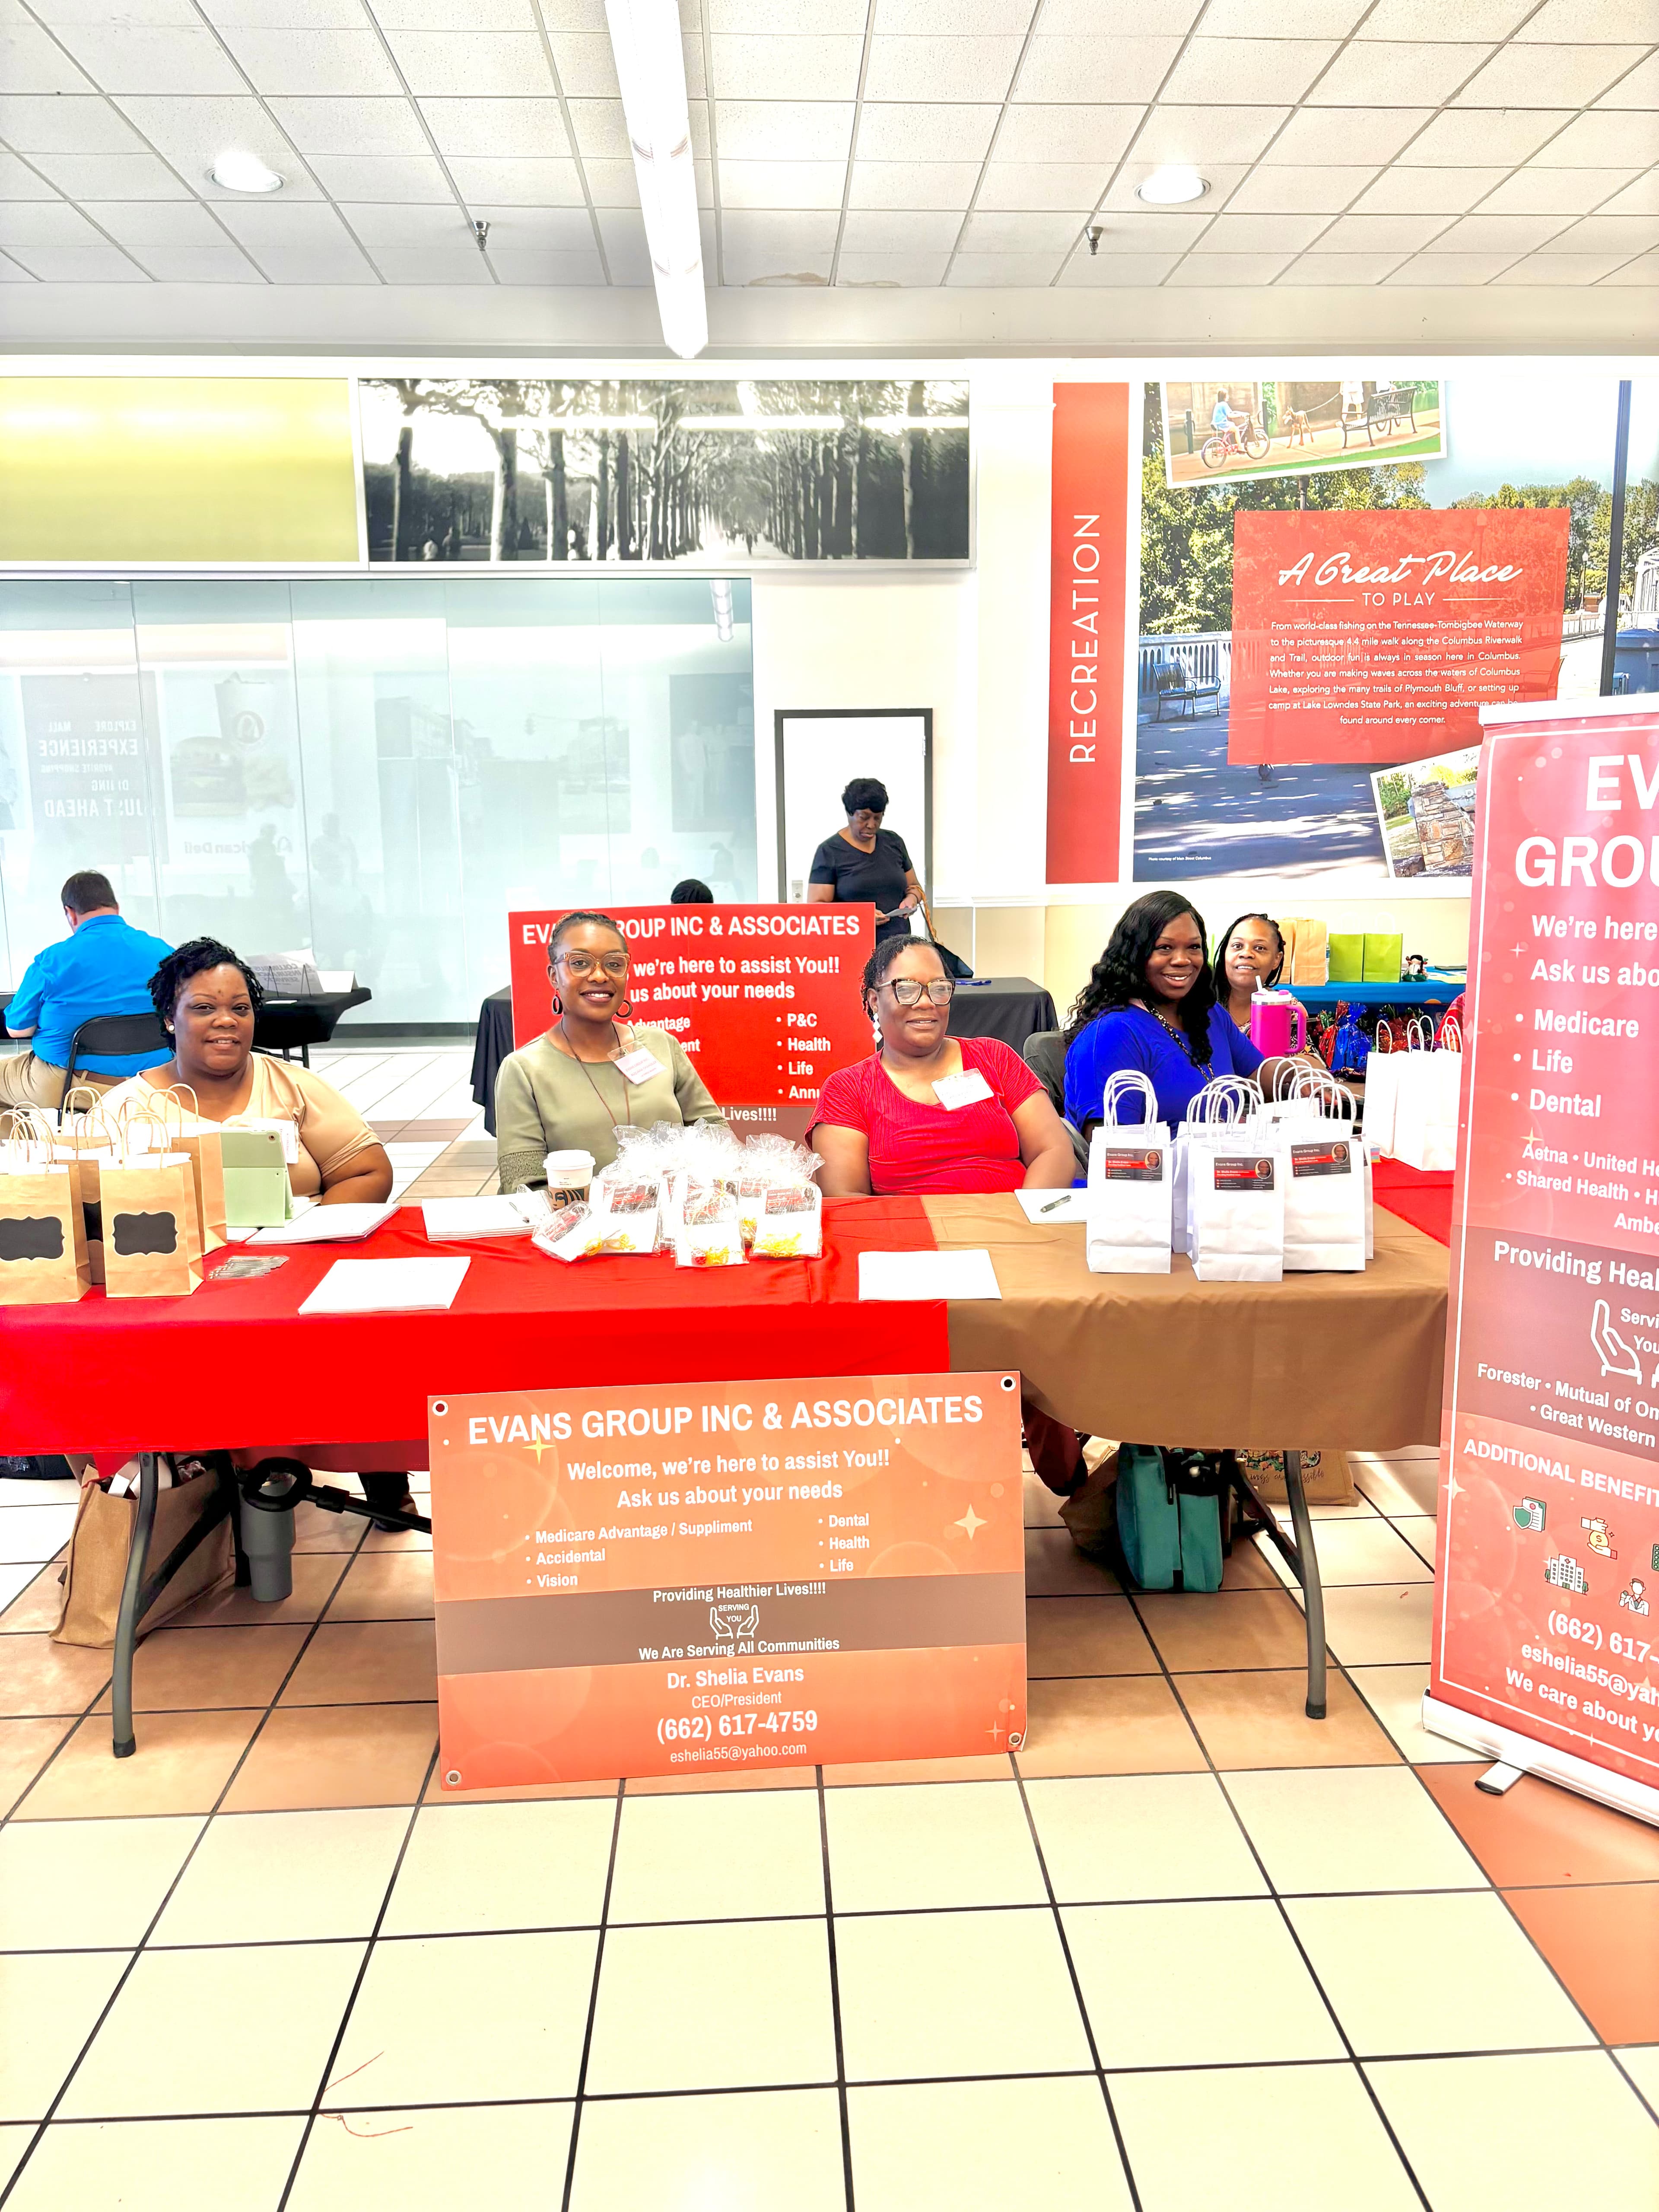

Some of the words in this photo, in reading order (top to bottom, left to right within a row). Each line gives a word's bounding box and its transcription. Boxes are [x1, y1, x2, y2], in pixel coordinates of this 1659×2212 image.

[1278, 552, 1314, 585] A
[1314, 553, 1425, 585] Great
[1422, 550, 1523, 585] Place
[1362, 593, 1385, 606] TO
[1393, 592, 1435, 606] PLAY
[1294, 621, 1337, 629] world-class
[1339, 621, 1365, 631] fishing
[1393, 620, 1482, 630] Tennessee-Tombigbee
[1484, 620, 1523, 629] Waterway
[1069, 515, 1100, 762] RECREATION
[1297, 638, 1344, 648] picturesque
[1402, 637, 1423, 647] along
[1442, 636, 1482, 644] Columbus
[1270, 653, 1285, 662] and
[1289, 653, 1307, 662] Trail,
[1312, 653, 1344, 661] outdoor
[1348, 653, 1360, 661] fun
[1374, 653, 1399, 662] always
[1478, 652, 1520, 660] Columbus.
[1270, 669, 1304, 677] Whether
[1340, 669, 1368, 679] making
[1269, 685, 1289, 694] Lake,
[1293, 685, 1330, 696] exploring
[1405, 684, 1441, 694] Plymouth
[1445, 683, 1464, 692] Bluff,
[1479, 684, 1505, 693] setting
[1324, 700, 1358, 709] Lowndes
[1384, 700, 1402, 709] Park,
[1417, 700, 1447, 709] exciting
[671, 917, 702, 935] INC
[710, 916, 723, 935] &
[728, 916, 859, 935] ASSOCIATES
[1532, 915, 1597, 938] We’re
[1604, 916, 1658, 941] here
[633, 959, 674, 976] we’re
[679, 957, 714, 973] here
[719, 957, 735, 973] to
[741, 956, 791, 973] assist
[795, 957, 839, 973] You!!
[1531, 959, 1576, 982] Ask
[1583, 966, 1610, 984] us
[630, 988, 649, 1002] us
[653, 983, 697, 1001] about
[702, 985, 739, 1001] your
[745, 981, 795, 998] needs
[788, 1014, 817, 1027] P&C
[1535, 1009, 1639, 1038] Medicare
[788, 1037, 831, 1052] Health
[788, 1061, 814, 1075] Life
[1532, 1049, 1573, 1074] Life
[1530, 1089, 1601, 1117] Dental
[721, 1107, 777, 1121] Lives!!!!
[1522, 1144, 1568, 1164] Aetna
[1583, 1151, 1637, 1174] United
[1516, 1170, 1571, 1192] Shared
[1576, 1179, 1629, 1201] Health
[1614, 1213, 1659, 1235] Ambe
[1494, 1240, 1602, 1285] Providing
[1609, 1261, 1659, 1292] Heal
[1621, 1308, 1659, 1329] Servi
[1634, 1335, 1659, 1355] You
[1478, 1363, 1541, 1390] Forester
[1555, 1381, 1609, 1408] Mutual
[1615, 1397, 1632, 1414] of
[469, 1413, 572, 1444] EVANS
[582, 1407, 692, 1437] GROUP
[702, 1404, 752, 1432] INC
[763, 1403, 783, 1430] &
[791, 1395, 982, 1428] ASSOCIATES
[1540, 1404, 1583, 1429] Great
[1587, 1416, 1656, 1448] Western
[567, 1461, 656, 1480] Welcome,
[662, 1457, 711, 1475] we’re
[717, 1455, 756, 1472] here
[761, 1454, 779, 1471] to
[785, 1451, 838, 1469] assist
[843, 1449, 889, 1467] You!!
[1463, 1438, 1576, 1483] ADDITIONAL
[617, 1489, 652, 1507] Ask
[658, 1492, 679, 1506] us
[685, 1486, 737, 1504] about
[742, 1487, 783, 1505] your
[789, 1481, 842, 1499] needs
[829, 1513, 869, 1527] Dental
[536, 1529, 595, 1543] Medicare
[598, 1525, 667, 1539] Advantage
[679, 1519, 752, 1536] Suppliment
[830, 1535, 870, 1550] Health
[536, 1548, 605, 1564] Accidental
[830, 1558, 854, 1572] Life
[537, 1574, 578, 1587] Vision
[654, 1588, 713, 1602] Providing
[717, 1585, 772, 1599] Healthier
[776, 1582, 825, 1595] Lives!!!!
[718, 1604, 750, 1612] SERVING
[1548, 1610, 1603, 1650] (662)
[639, 1648, 658, 1663] We
[661, 1646, 683, 1662] Are
[687, 1643, 735, 1660] Serving
[738, 1641, 754, 1653] All
[758, 1638, 842, 1656] Communities
[668, 1673, 690, 1688] Dr.
[696, 1668, 748, 1687] Shelia
[753, 1668, 804, 1683] Evans
[692, 1691, 781, 1708] CEO/President
[1506, 1667, 1533, 1692] We
[1538, 1684, 1577, 1710] care
[1582, 1700, 1637, 1734] about
[658, 1716, 711, 1744] (662)
[719, 1710, 817, 1736] 617-4759
[671, 1744, 806, 1762] eshelia55@yahoo.com
